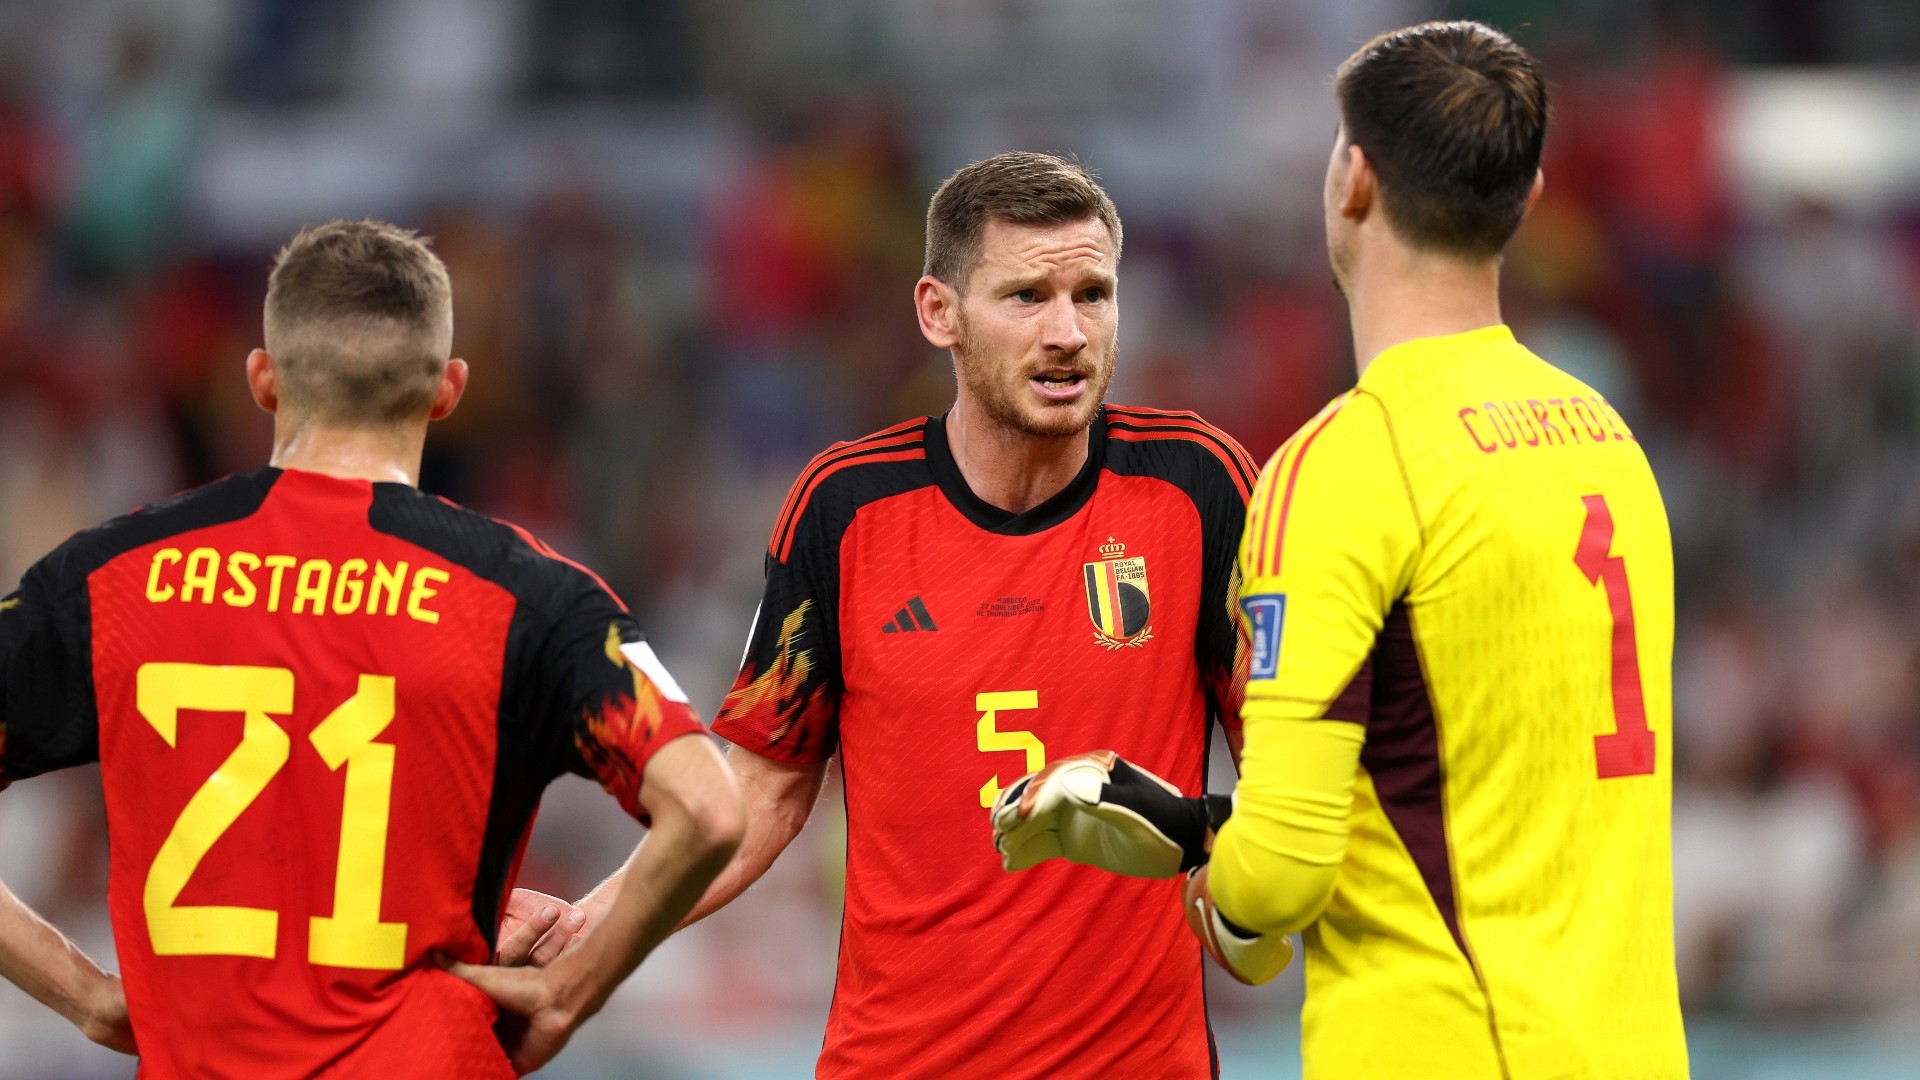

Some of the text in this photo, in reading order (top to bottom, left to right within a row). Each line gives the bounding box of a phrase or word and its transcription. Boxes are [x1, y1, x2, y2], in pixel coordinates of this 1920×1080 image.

[145, 547, 450, 624] CASTAGNE
[1114, 560, 1136, 568] ROYAL
[1115, 565, 1144, 575] BELGIAN
[1573, 494, 1655, 779] 1
[976, 690, 1045, 809] 5
[136, 662, 408, 970] 21
